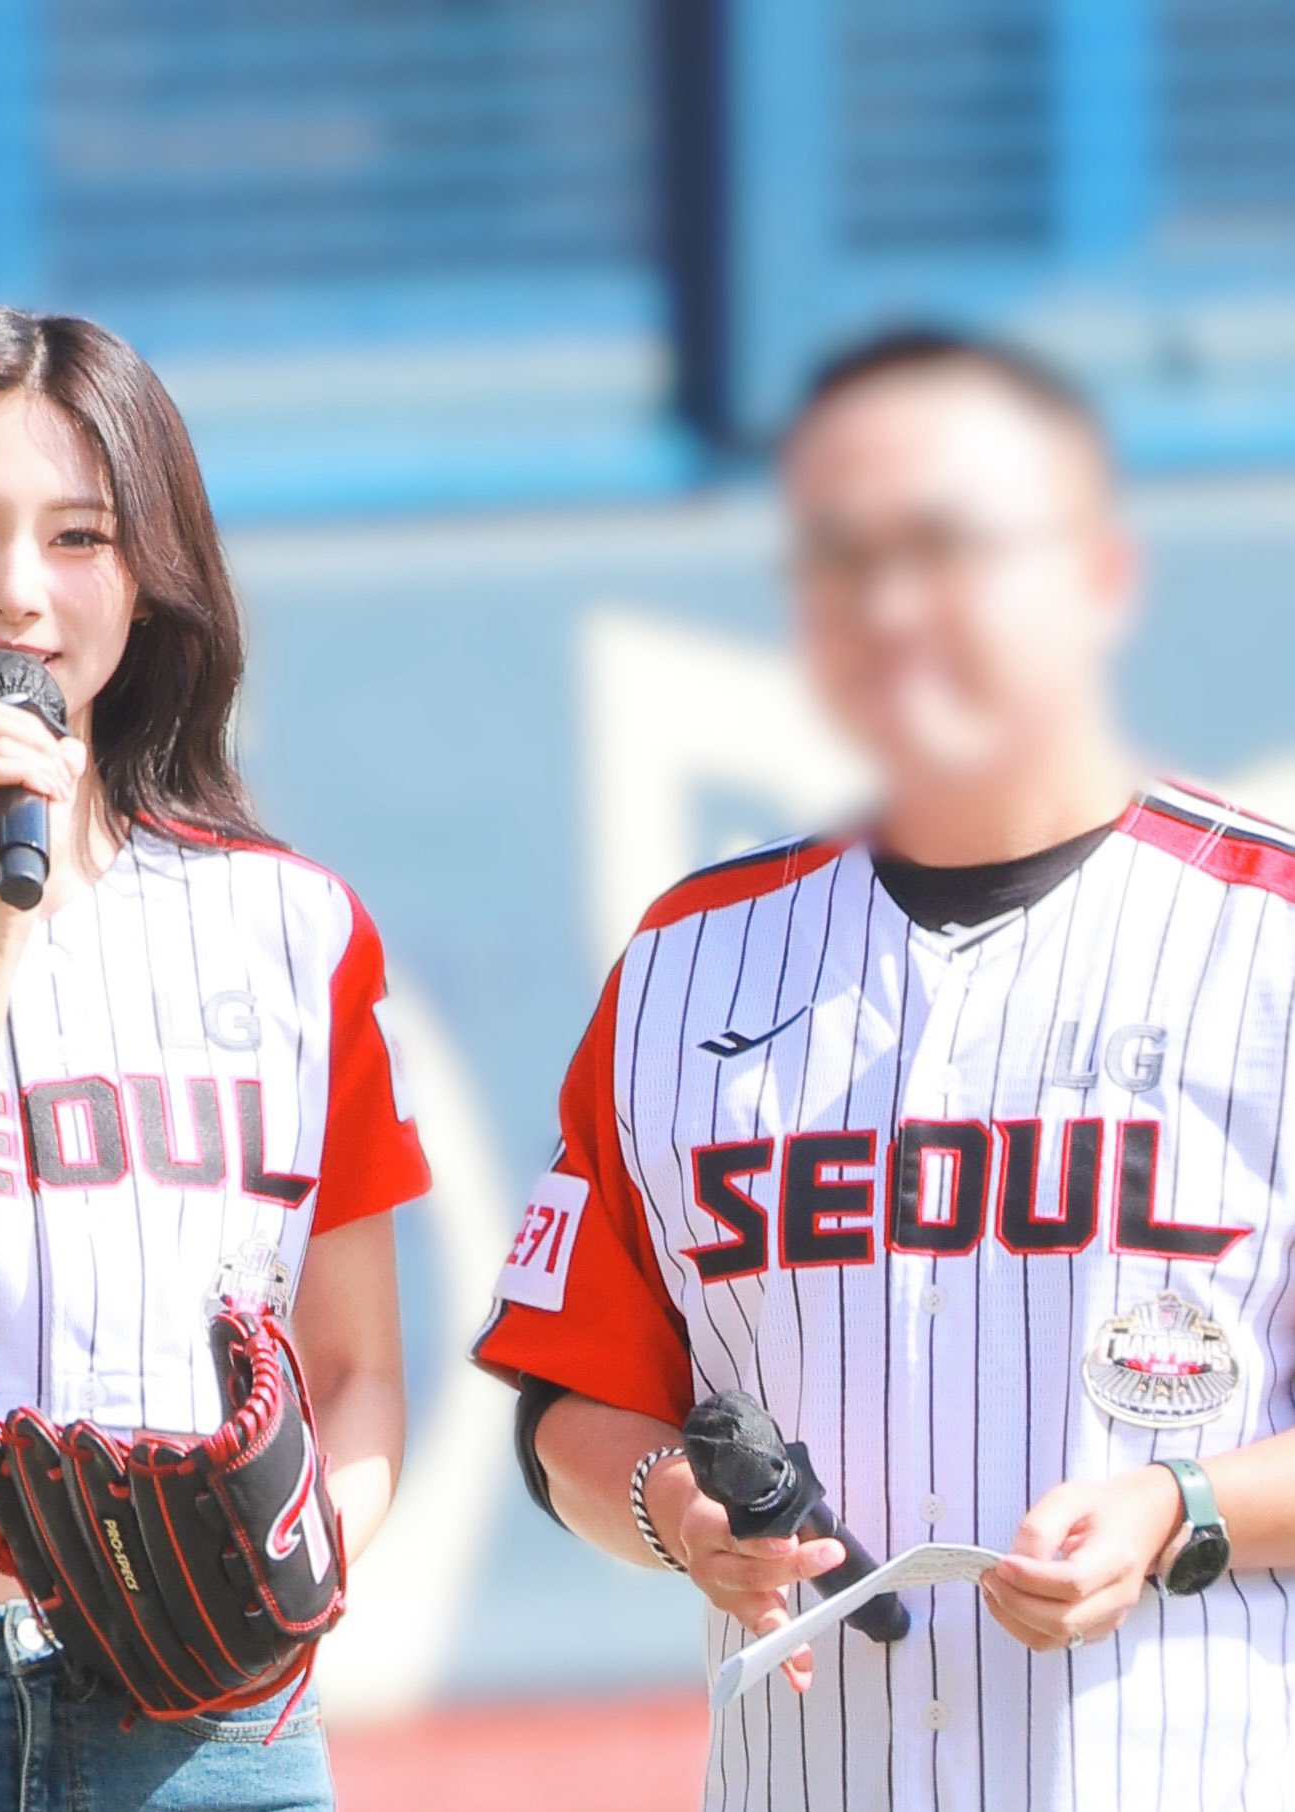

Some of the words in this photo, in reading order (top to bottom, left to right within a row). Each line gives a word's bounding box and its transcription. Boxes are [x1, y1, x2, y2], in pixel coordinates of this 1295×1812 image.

[158, 989, 263, 1053] LG
[1051, 1020, 1168, 1094] LG
[679, 1115, 1255, 1285] SEOUL
[103, 1518, 140, 1592] PRO-SPECS
